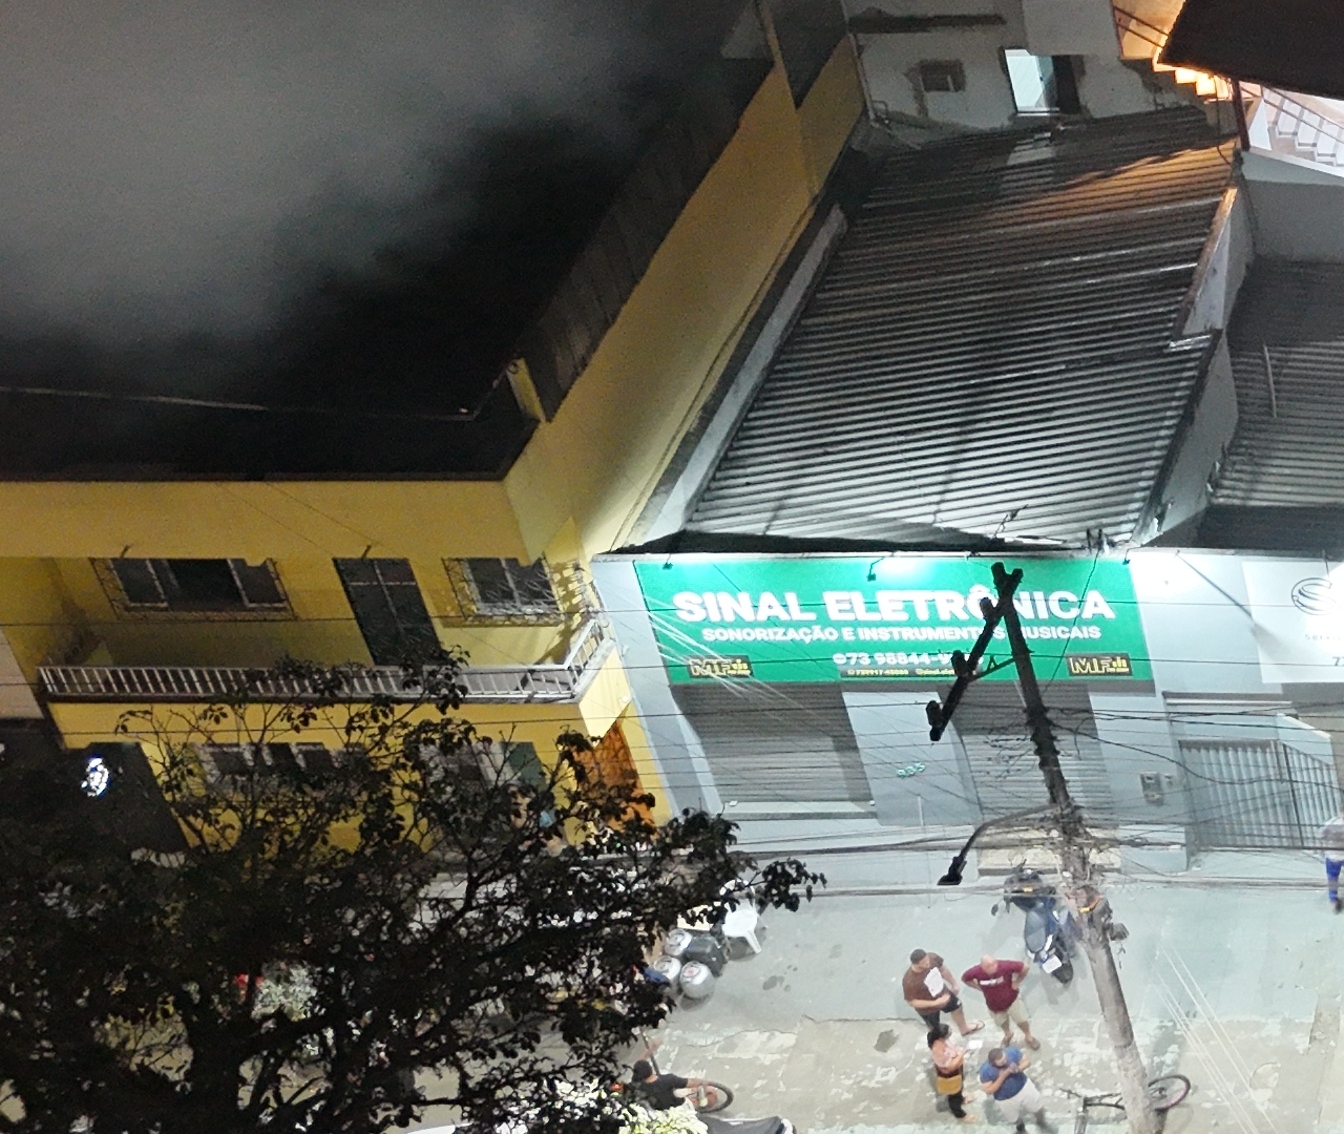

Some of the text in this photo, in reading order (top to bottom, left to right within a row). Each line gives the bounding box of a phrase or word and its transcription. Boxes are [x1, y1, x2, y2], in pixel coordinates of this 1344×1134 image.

[672, 584, 1116, 623] SINAL ELETRÔNICA
[701, 625, 839, 644] SONORIZAÇÃO
[842, 627, 857, 641] E
[858, 626, 1006, 641] INSTRUMENTS
[846, 652, 871, 666] 73
